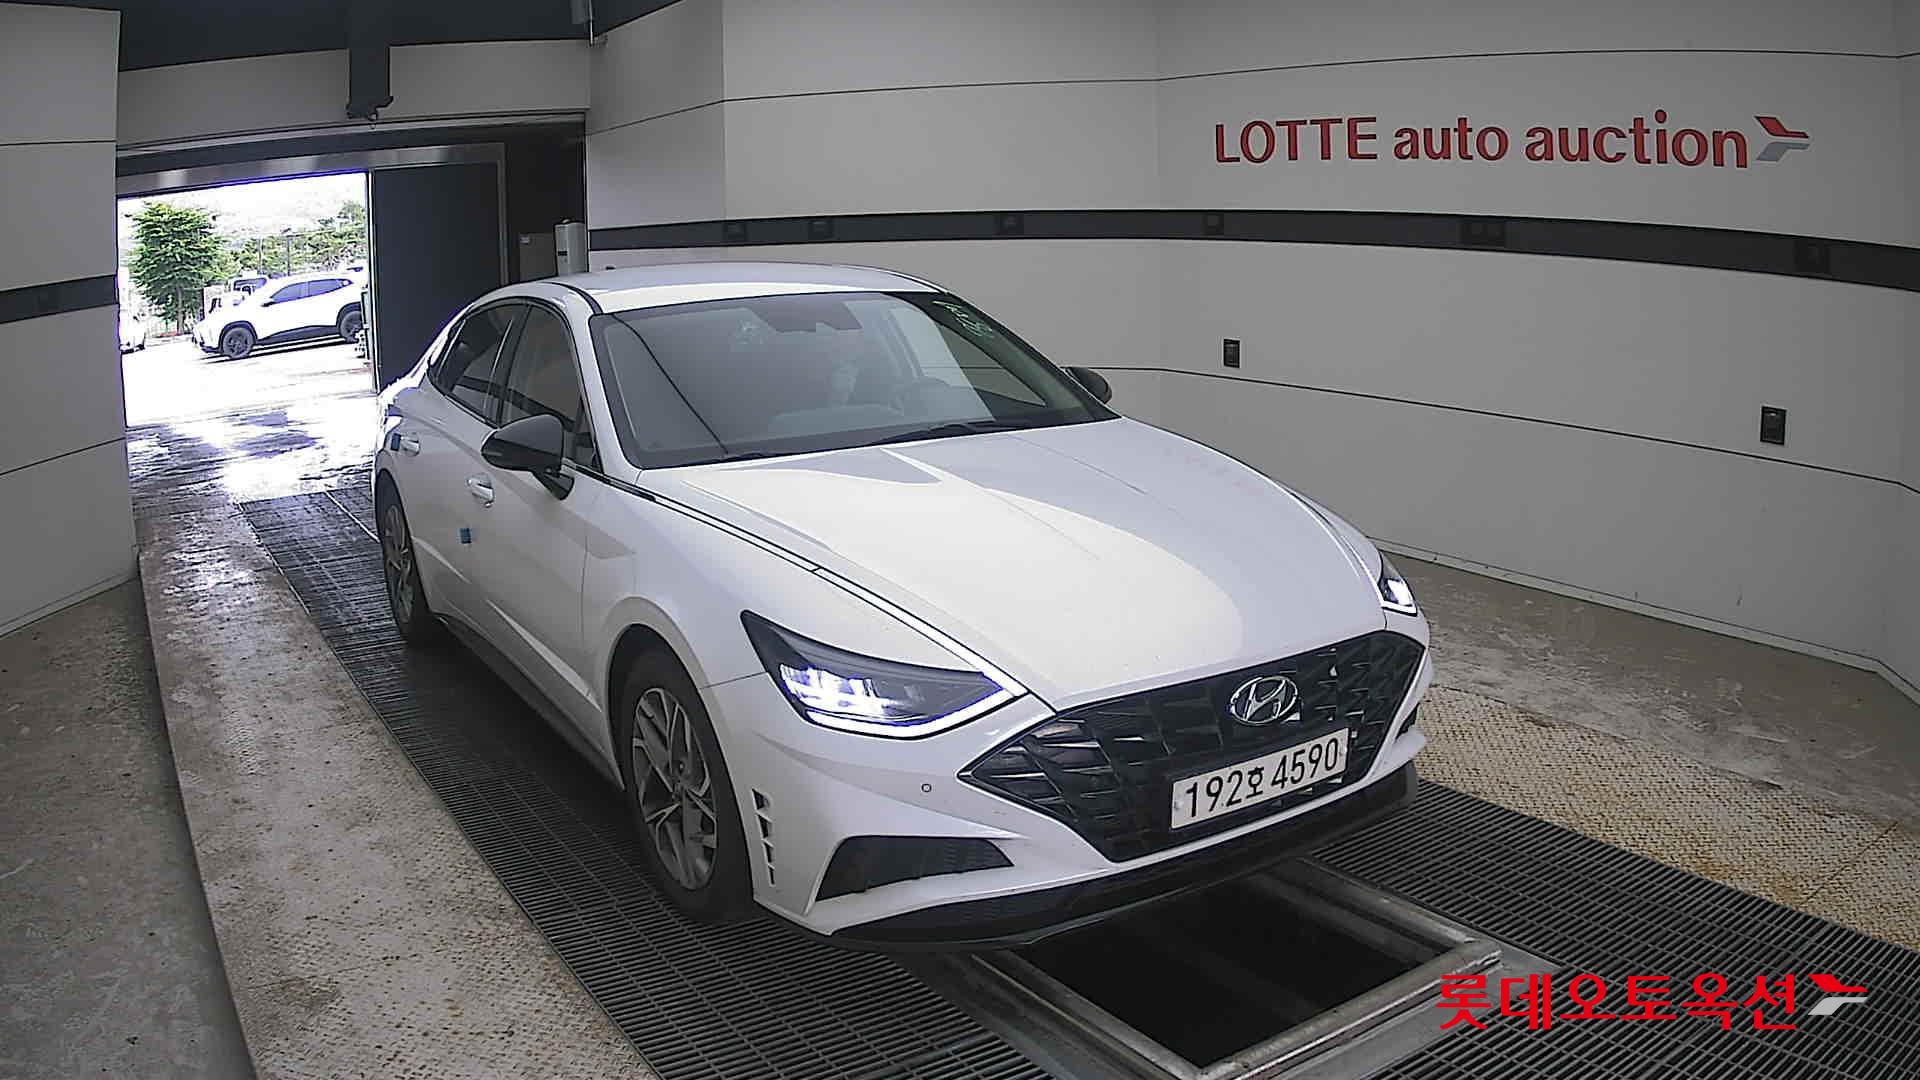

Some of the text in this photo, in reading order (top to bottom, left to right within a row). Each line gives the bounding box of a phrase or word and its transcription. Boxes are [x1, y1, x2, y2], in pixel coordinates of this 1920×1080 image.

[1214, 109, 1749, 169] LOTTE auto auction
[1270, 738, 1339, 790] 4590
